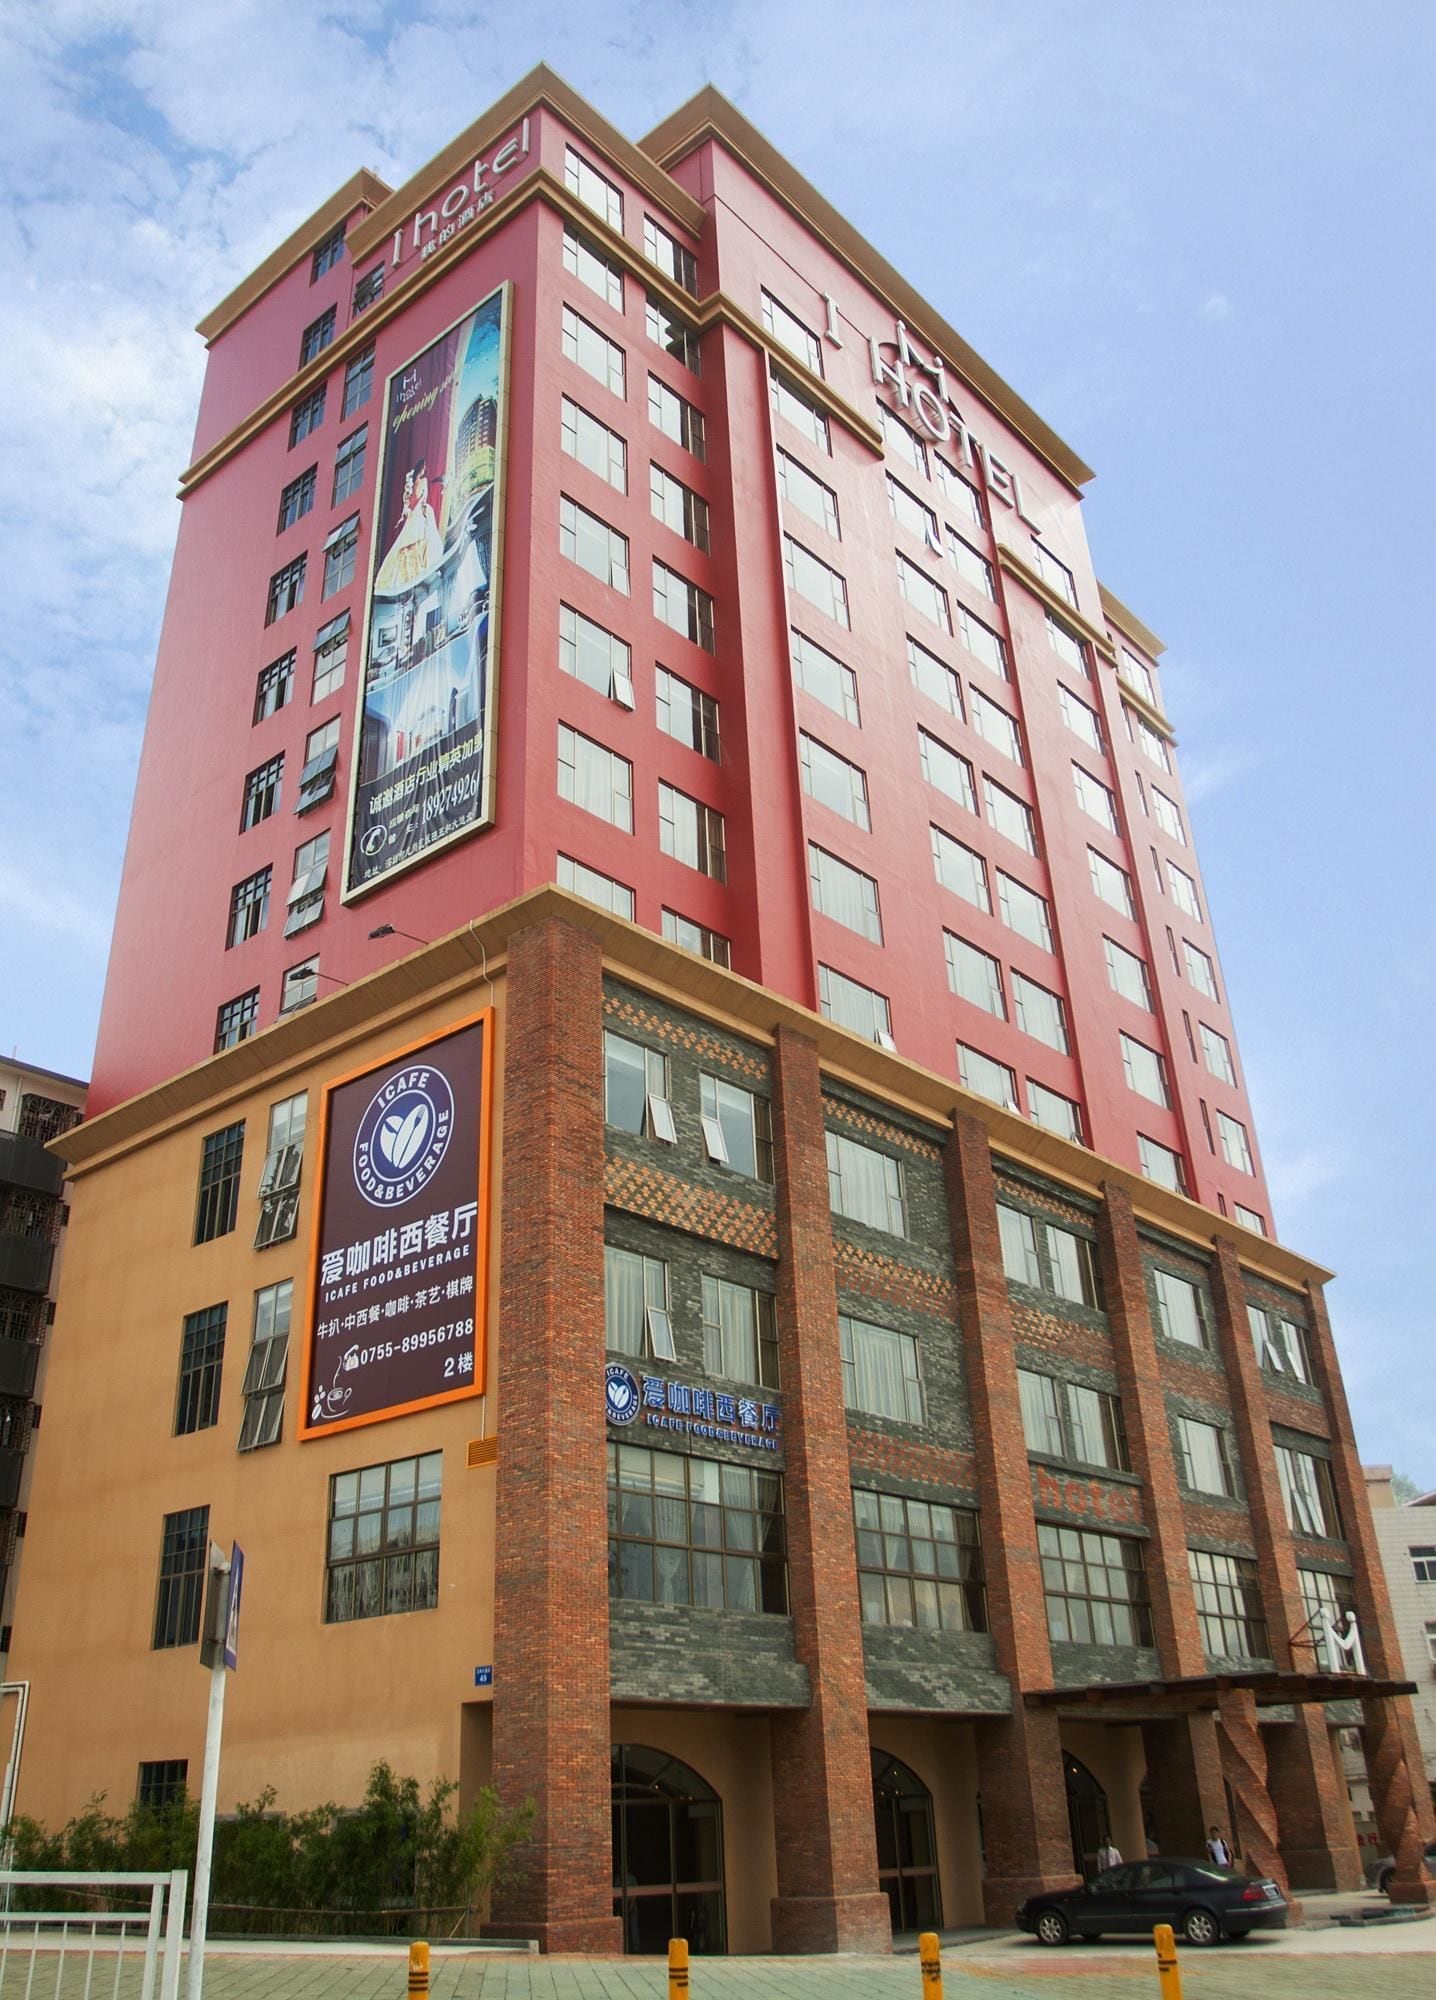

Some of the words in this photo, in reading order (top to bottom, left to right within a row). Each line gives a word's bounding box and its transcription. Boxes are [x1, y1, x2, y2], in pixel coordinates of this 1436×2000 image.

[413, 117, 529, 248] hotel
[868, 335, 1042, 535] HOTEL
[377, 1072, 430, 1109] ICAFE
[320, 1201, 478, 1286] 爱咖啡西餐厅
[325, 1285, 358, 1303] ICAFE
[363, 1244, 470, 1290] FOOD&BEVERAGE
[360, 1318, 474, 1365] 0755-89956788
[643, 1375, 781, 1433] 爱咖啡西餐厅
[647, 1413, 683, 1432] ICAFE
[1036, 1465, 1142, 1525] hotel
